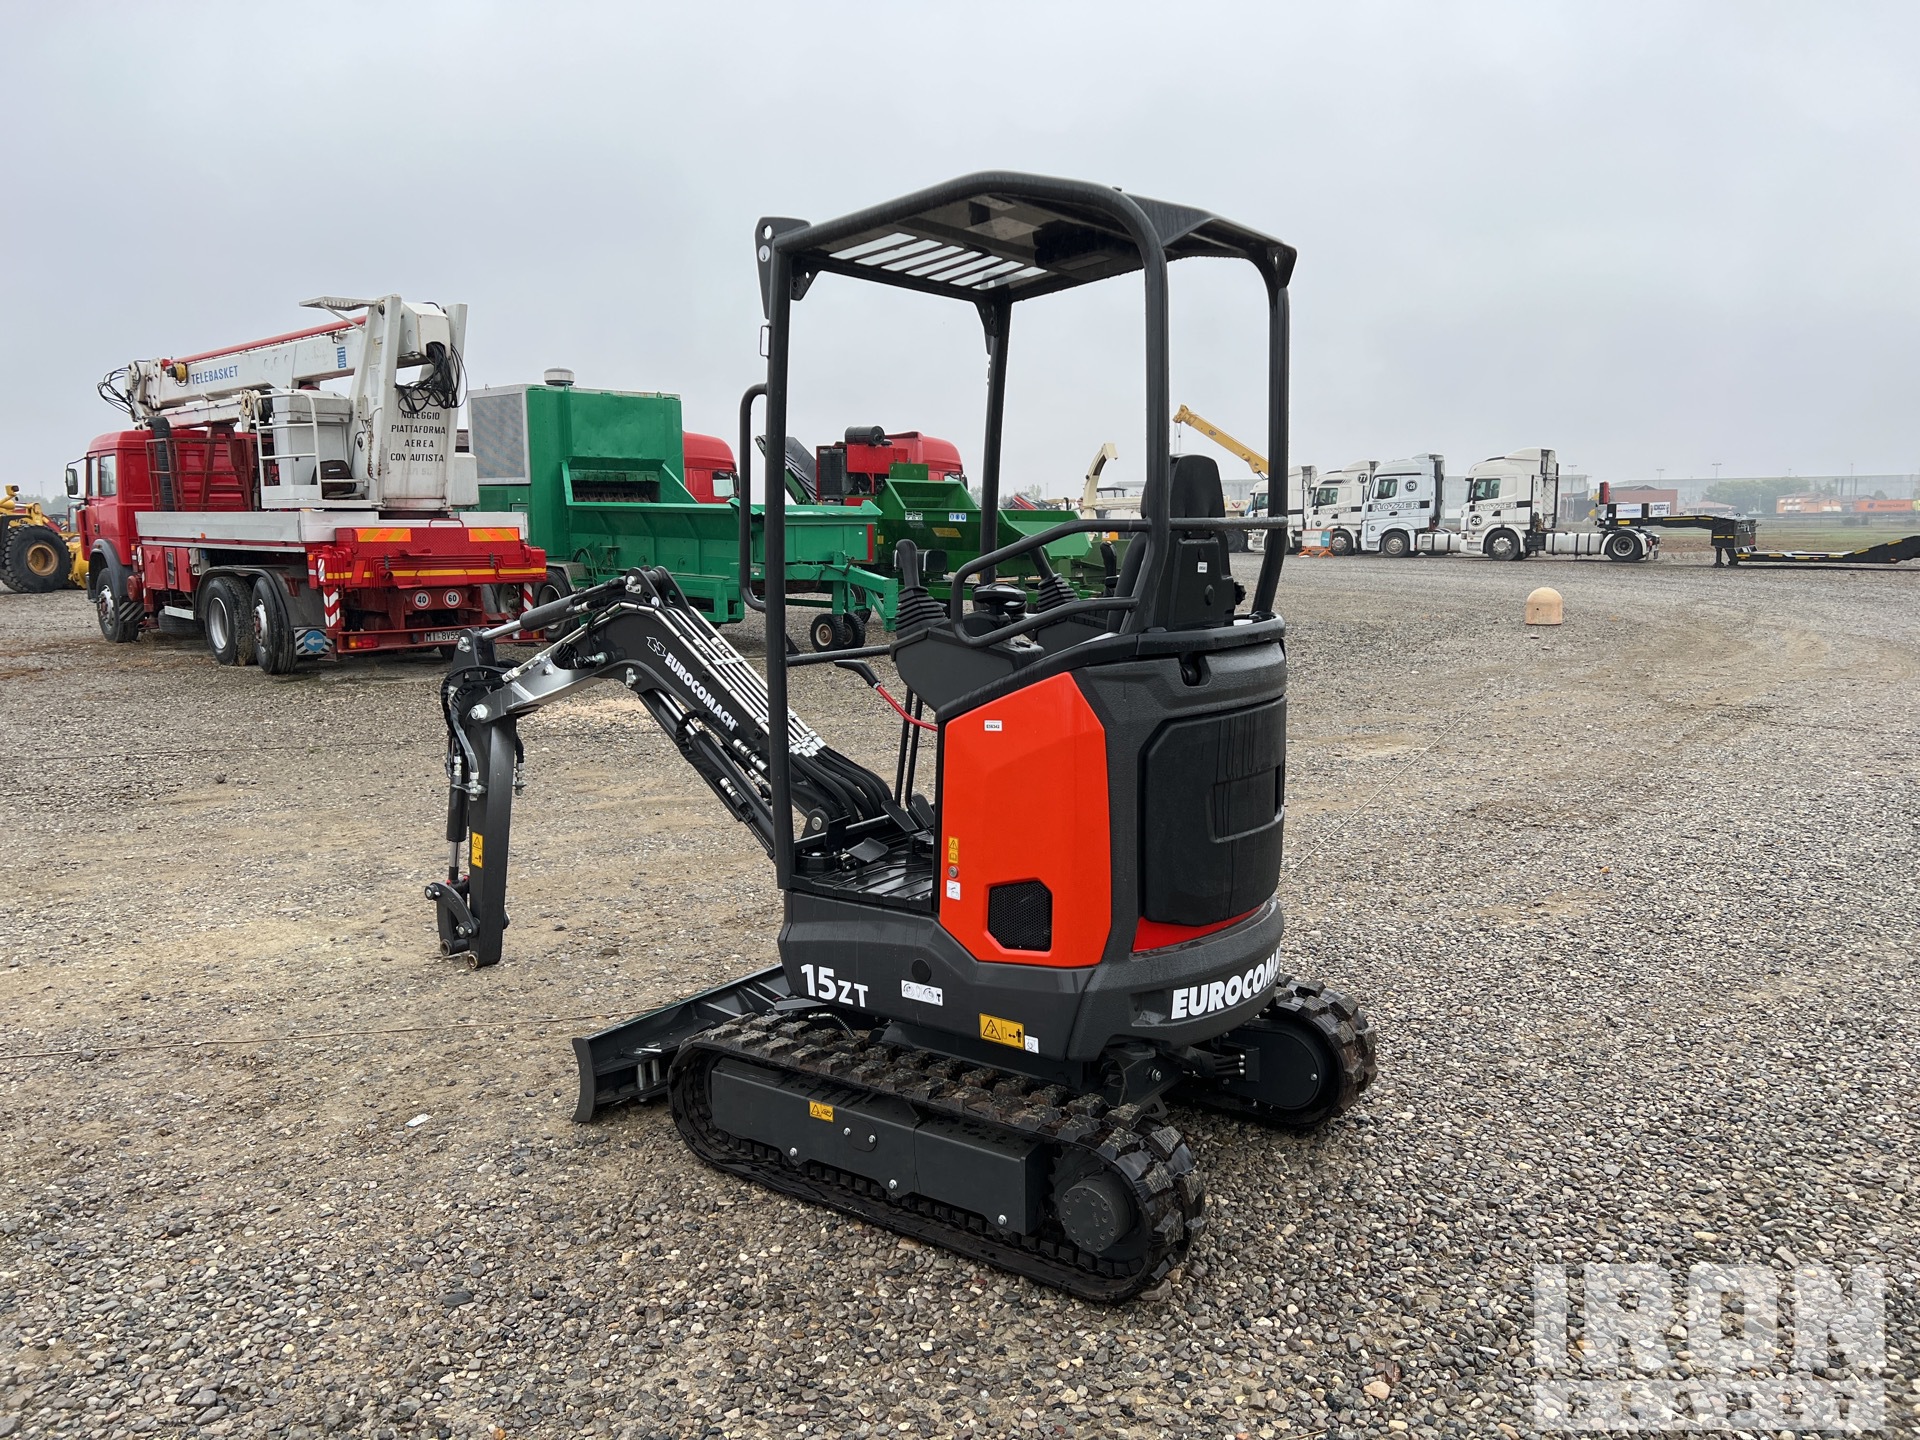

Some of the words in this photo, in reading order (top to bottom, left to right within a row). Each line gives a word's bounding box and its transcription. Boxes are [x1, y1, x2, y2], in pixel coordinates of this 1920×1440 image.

[191, 365, 239, 385] TELEBASKET
[402, 411, 440, 420] NOLEGGIO
[391, 424, 446, 435] PIATTAFORMA
[404, 439, 434, 448] AEREA
[390, 452, 406, 462] CON
[410, 453, 444, 462] AUTISTA
[417, 596, 427, 604] 40
[447, 594, 457, 602] 60
[664, 652, 737, 732] EUROCOMACH
[800, 963, 869, 1008] 15ZT
